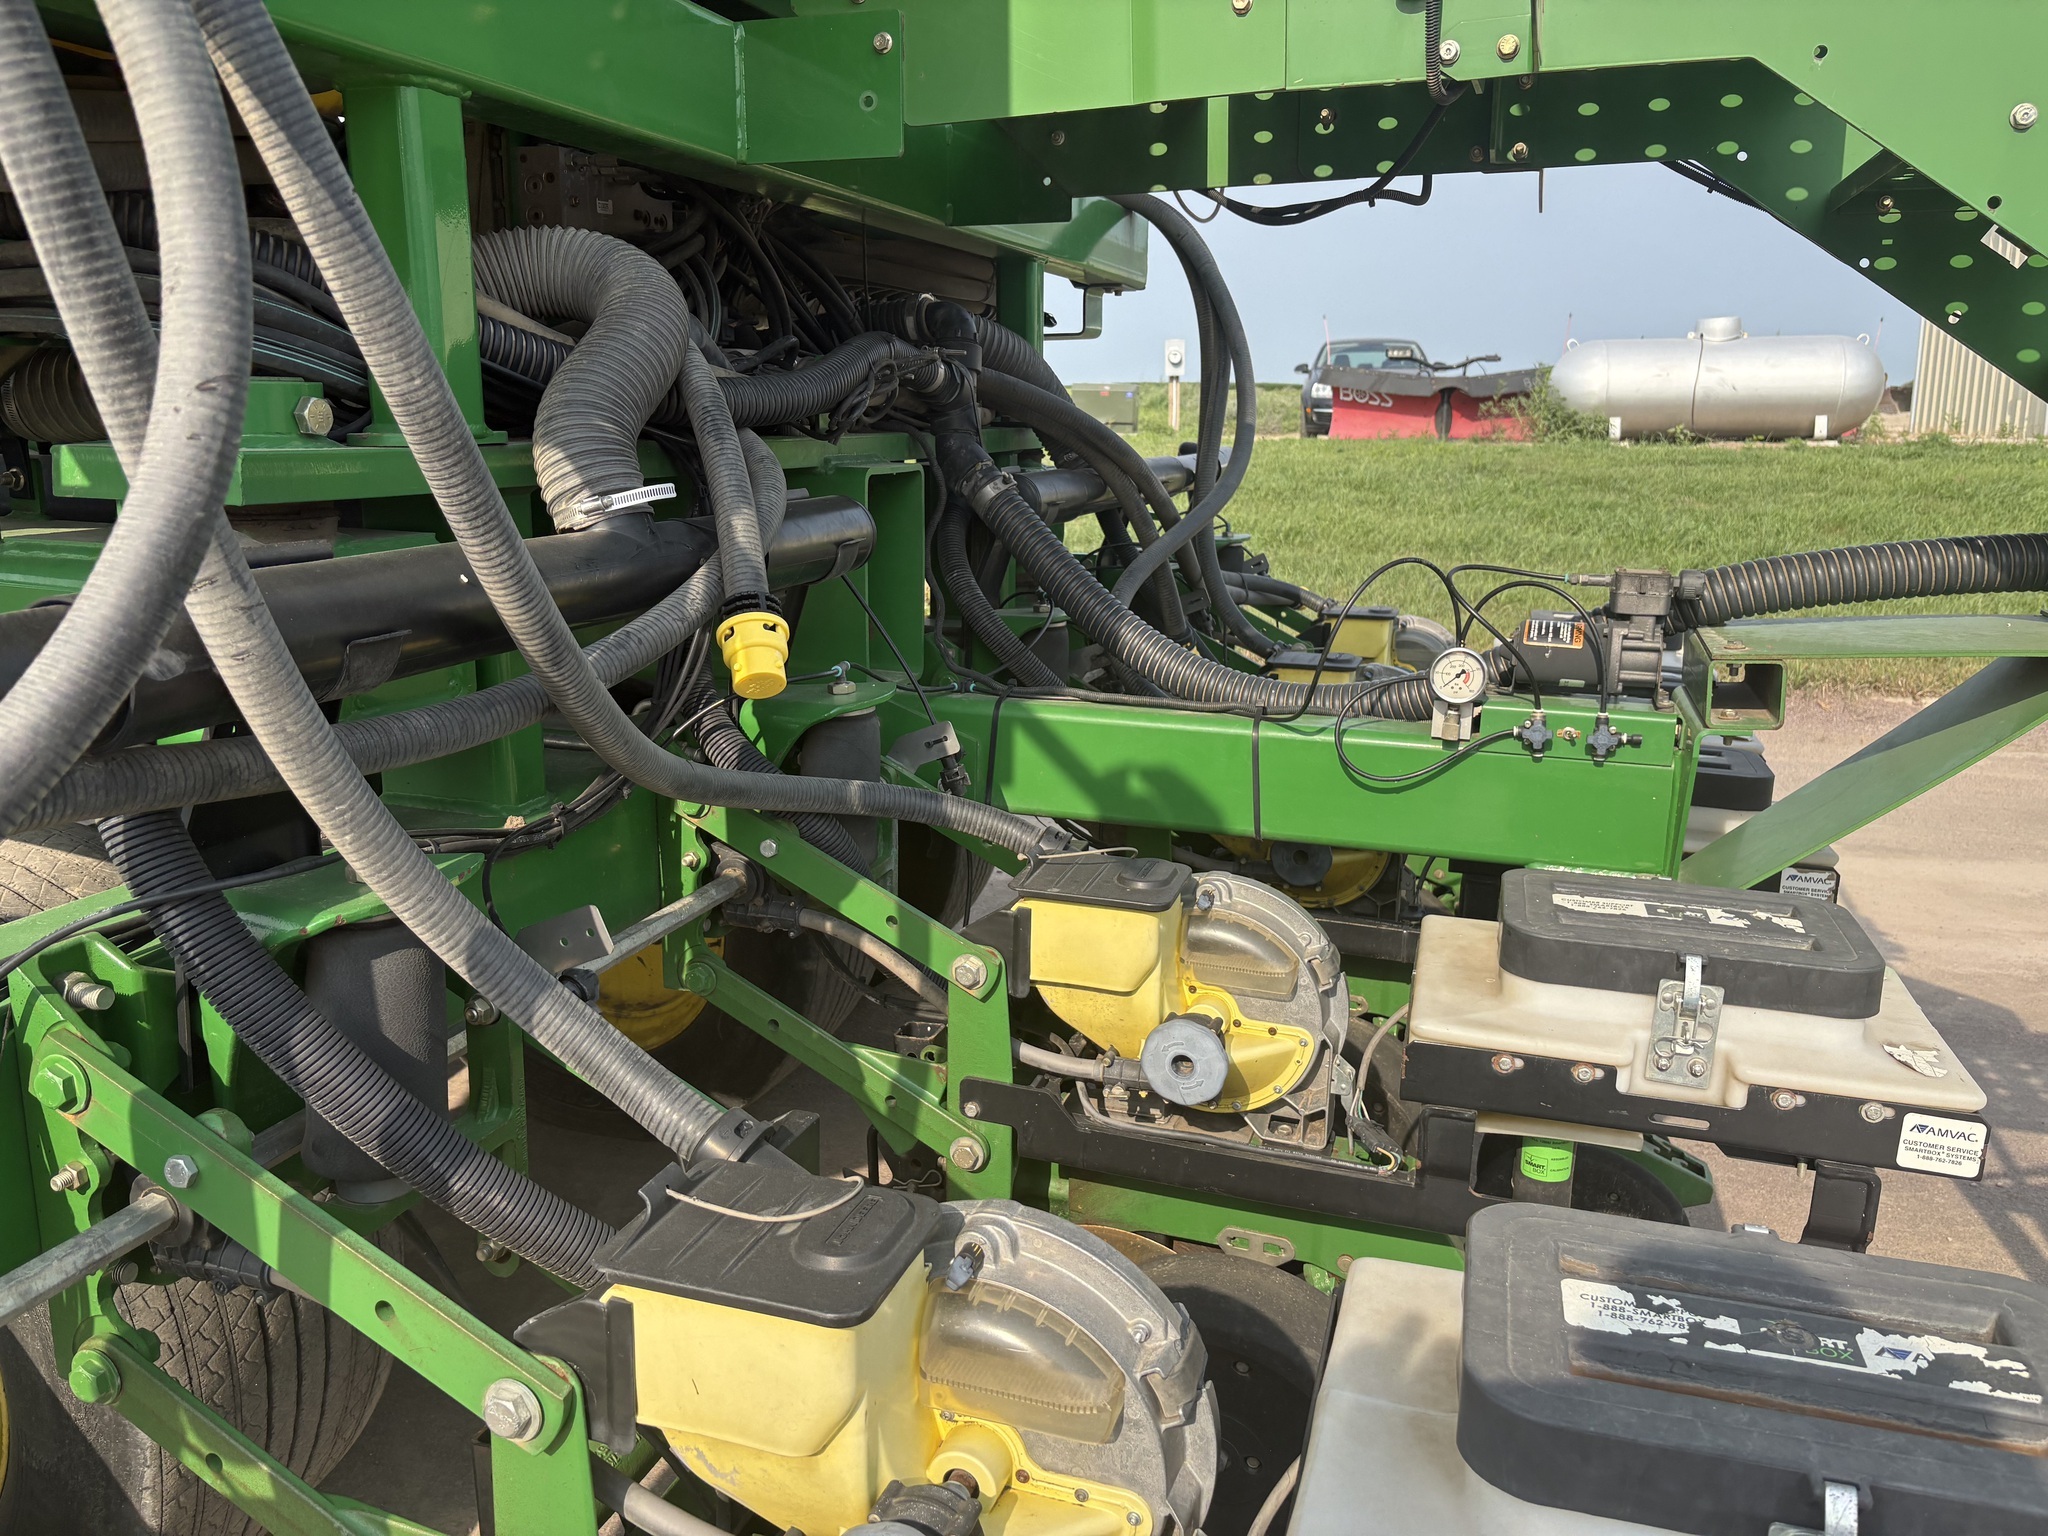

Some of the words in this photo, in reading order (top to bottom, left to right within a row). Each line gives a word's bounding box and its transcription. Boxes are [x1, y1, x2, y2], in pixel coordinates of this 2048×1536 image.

[1340, 387, 1393, 407] BOSS
[1797, 875, 1833, 885] AMVAC
[1782, 884, 1810, 892] CUSTOMER
[1903, 1139, 1945, 1151] CUSTOMER
[1946, 1145, 1980, 1157] SERVICE
[1917, 1154, 1963, 1166] 1-888-762-7826
[1945, 1152, 1977, 1162] SYSTEMS
[1580, 1293, 1637, 1307] CUSTOM
[1598, 1311, 1687, 1330] 1-888-762-78
